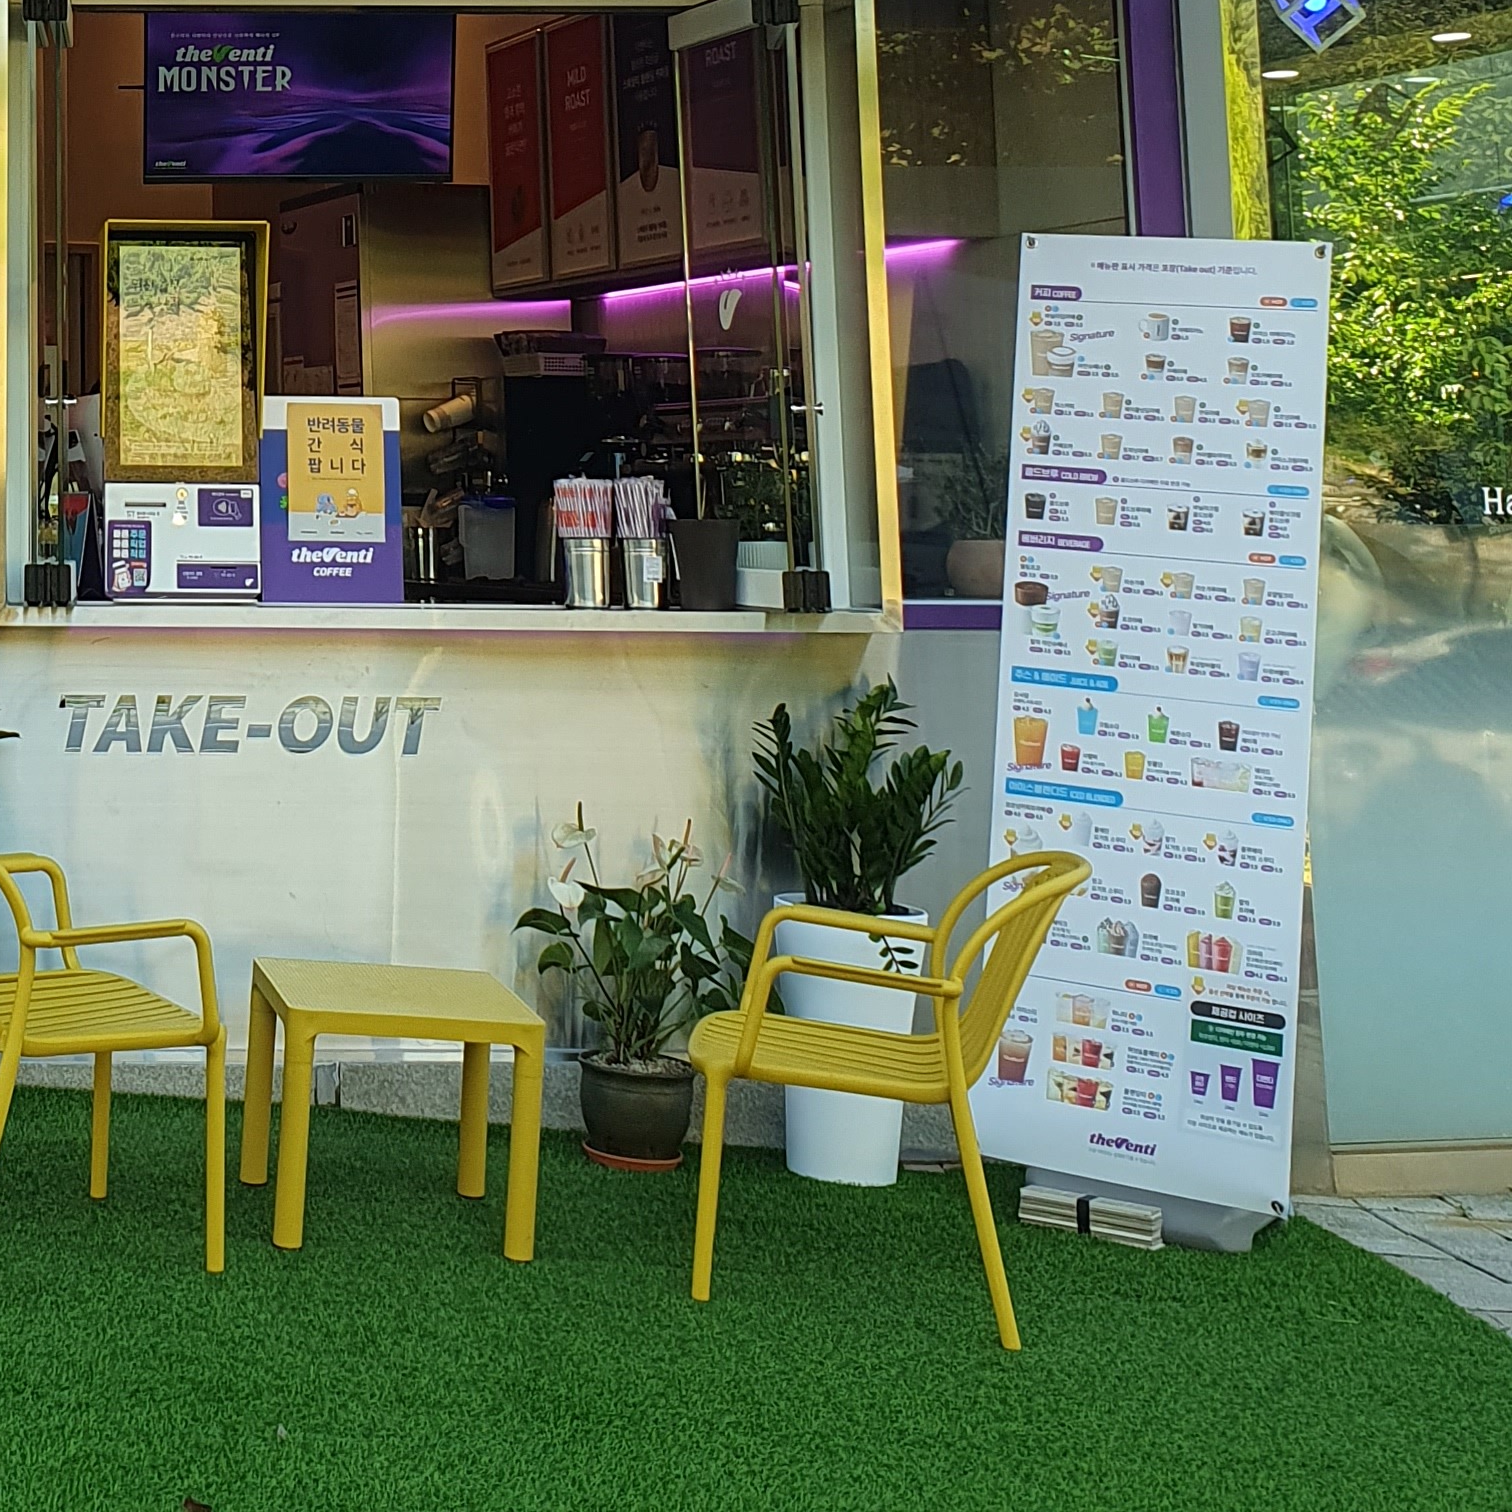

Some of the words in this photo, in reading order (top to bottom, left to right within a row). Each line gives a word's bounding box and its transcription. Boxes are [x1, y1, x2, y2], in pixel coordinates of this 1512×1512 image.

[157, 66, 293, 92] MONSTER
[1070, 330, 1115, 343] Signature
[307, 417, 365, 433] 반려동물
[313, 567, 354, 577] COFFEE
[58, 693, 443, 757] TAKE-OUT
[1211, 1006, 1237, 1020] 제공컵
[1238, 1010, 1265, 1024] 사이즈
